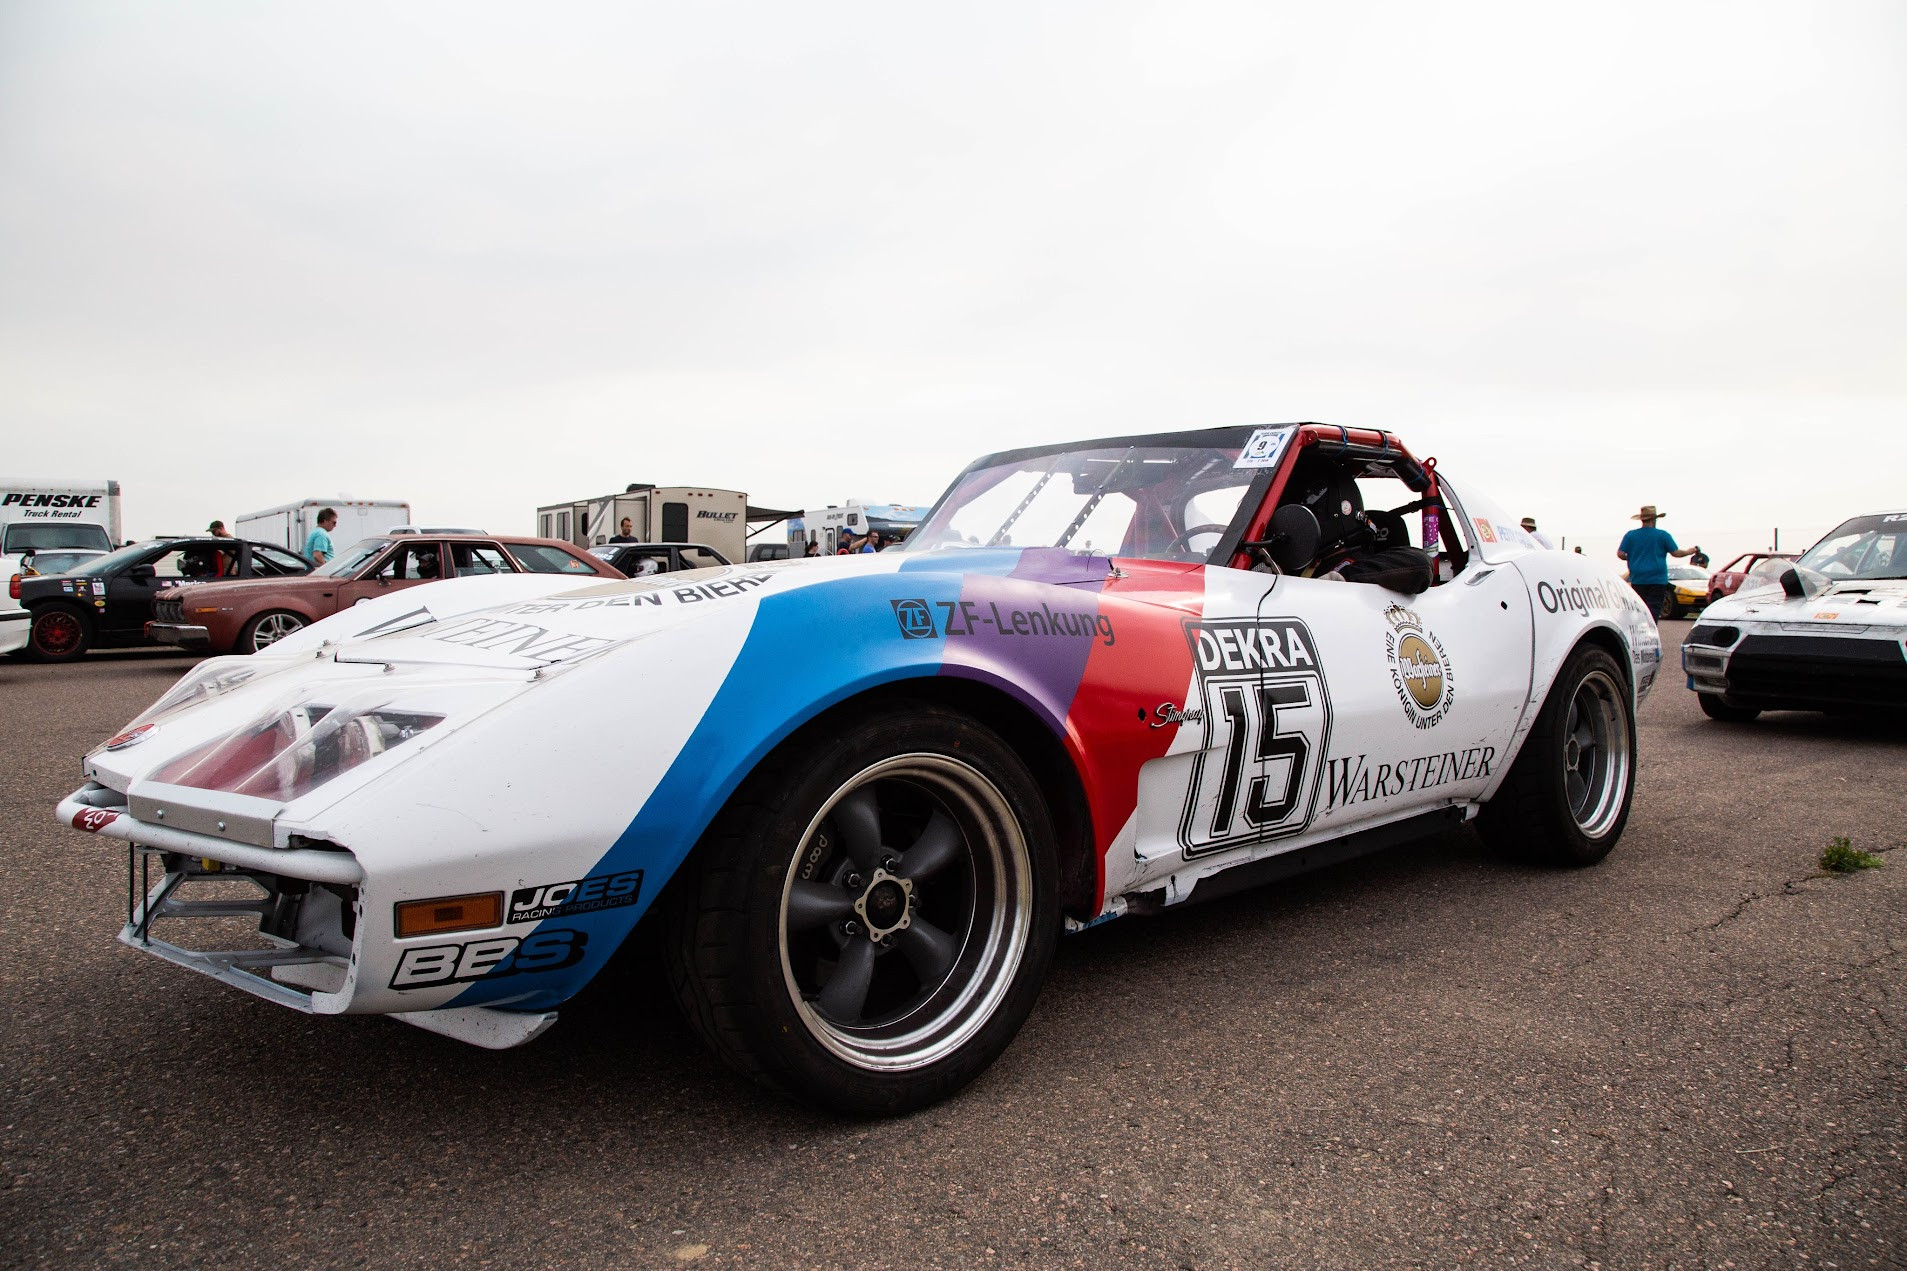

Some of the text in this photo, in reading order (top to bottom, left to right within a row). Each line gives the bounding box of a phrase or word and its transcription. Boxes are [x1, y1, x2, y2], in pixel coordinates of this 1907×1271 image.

[2, 493, 102, 508] PENSKE
[696, 510, 739, 519] BULLET
[1537, 578, 1611, 617] Original
[897, 604, 933, 633] ZF
[936, 601, 1115, 646] ZF-Lenkung
[1198, 627, 1313, 671] DEKRA
[1386, 631, 1396, 664] EINE
[1429, 631, 1454, 682] BIEREN
[1150, 702, 1203, 727] Stingray
[1442, 685, 1454, 715] DEN
[1415, 710, 1442, 730] UNTER
[1210, 681, 1313, 839] 15
[512, 894, 633, 922] RACING PRODUCTS
[514, 873, 639, 911] JOES
[391, 930, 582, 988] BBS
